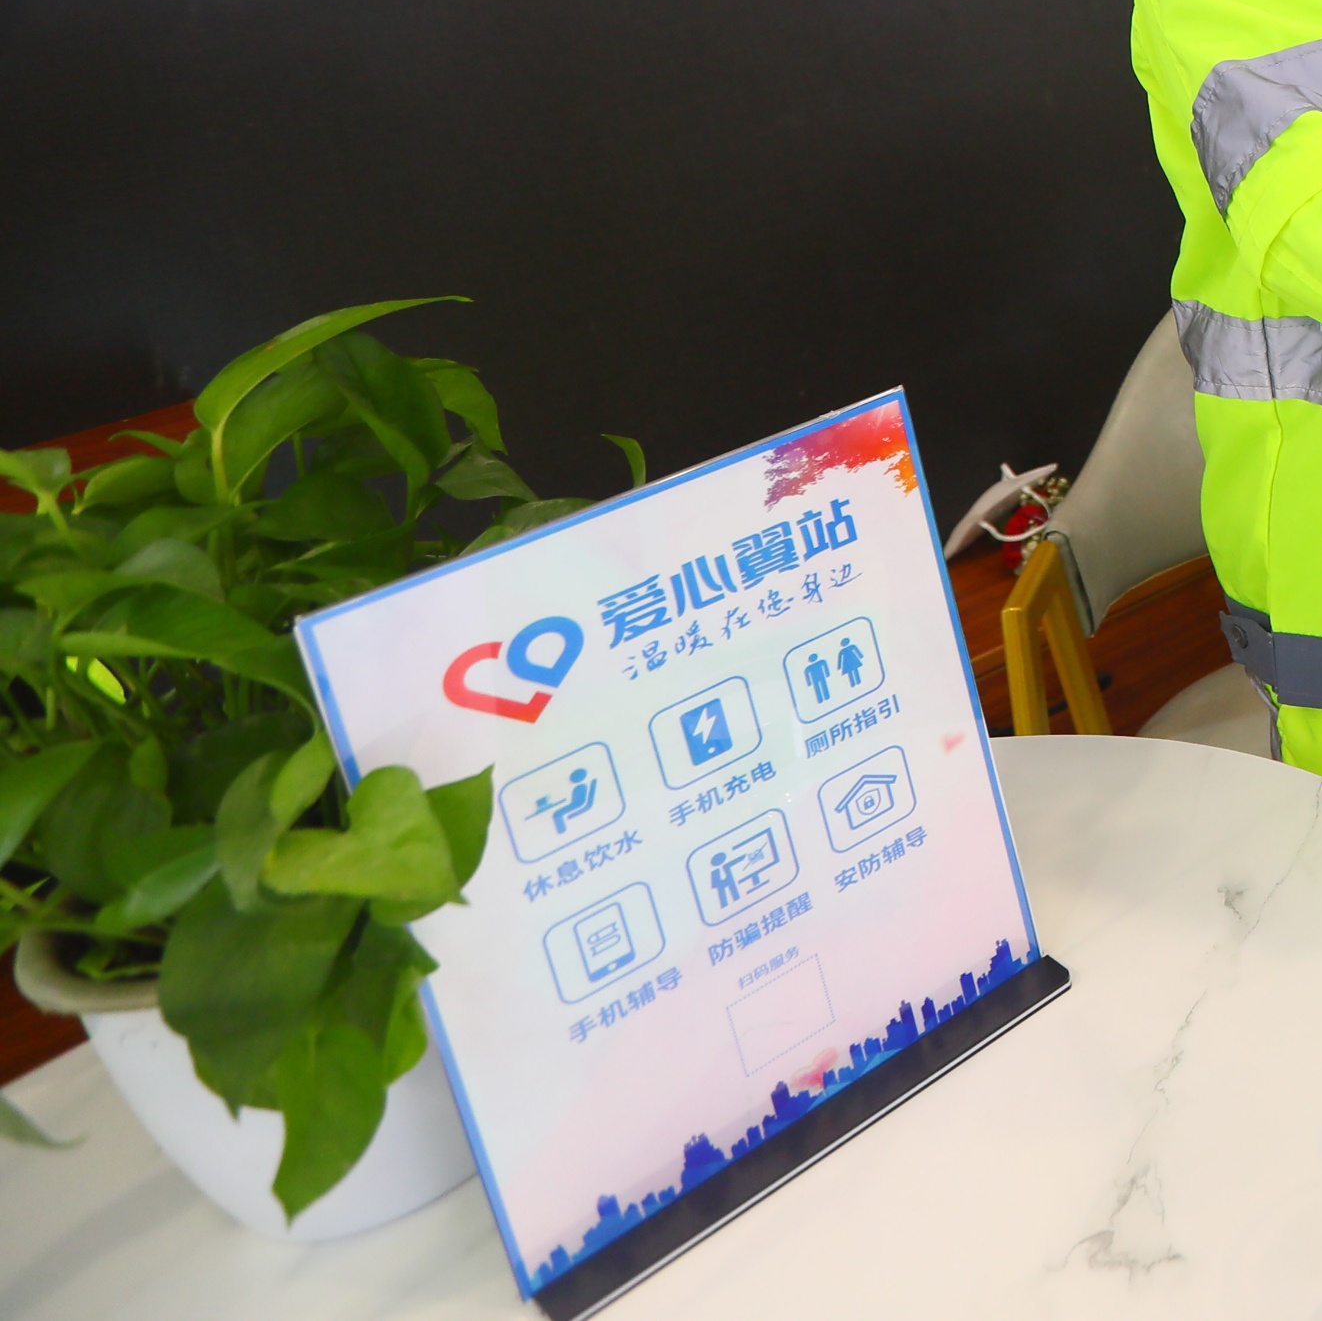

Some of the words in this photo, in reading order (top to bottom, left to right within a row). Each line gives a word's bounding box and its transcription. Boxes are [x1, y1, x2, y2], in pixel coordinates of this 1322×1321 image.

[596, 498, 859, 650] 爱心翼站
[621, 562, 863, 681] 温暖在您身边
[804, 693, 902, 759] 厕所指引
[668, 760, 777, 827] 手机充电
[522, 829, 644, 903] 休息饮水
[833, 825, 929, 894] 安防辅导
[707, 890, 815, 967] 防骗提醒
[568, 965, 684, 1045] 手机辅导
[737, 945, 801, 991] 扫码服务
